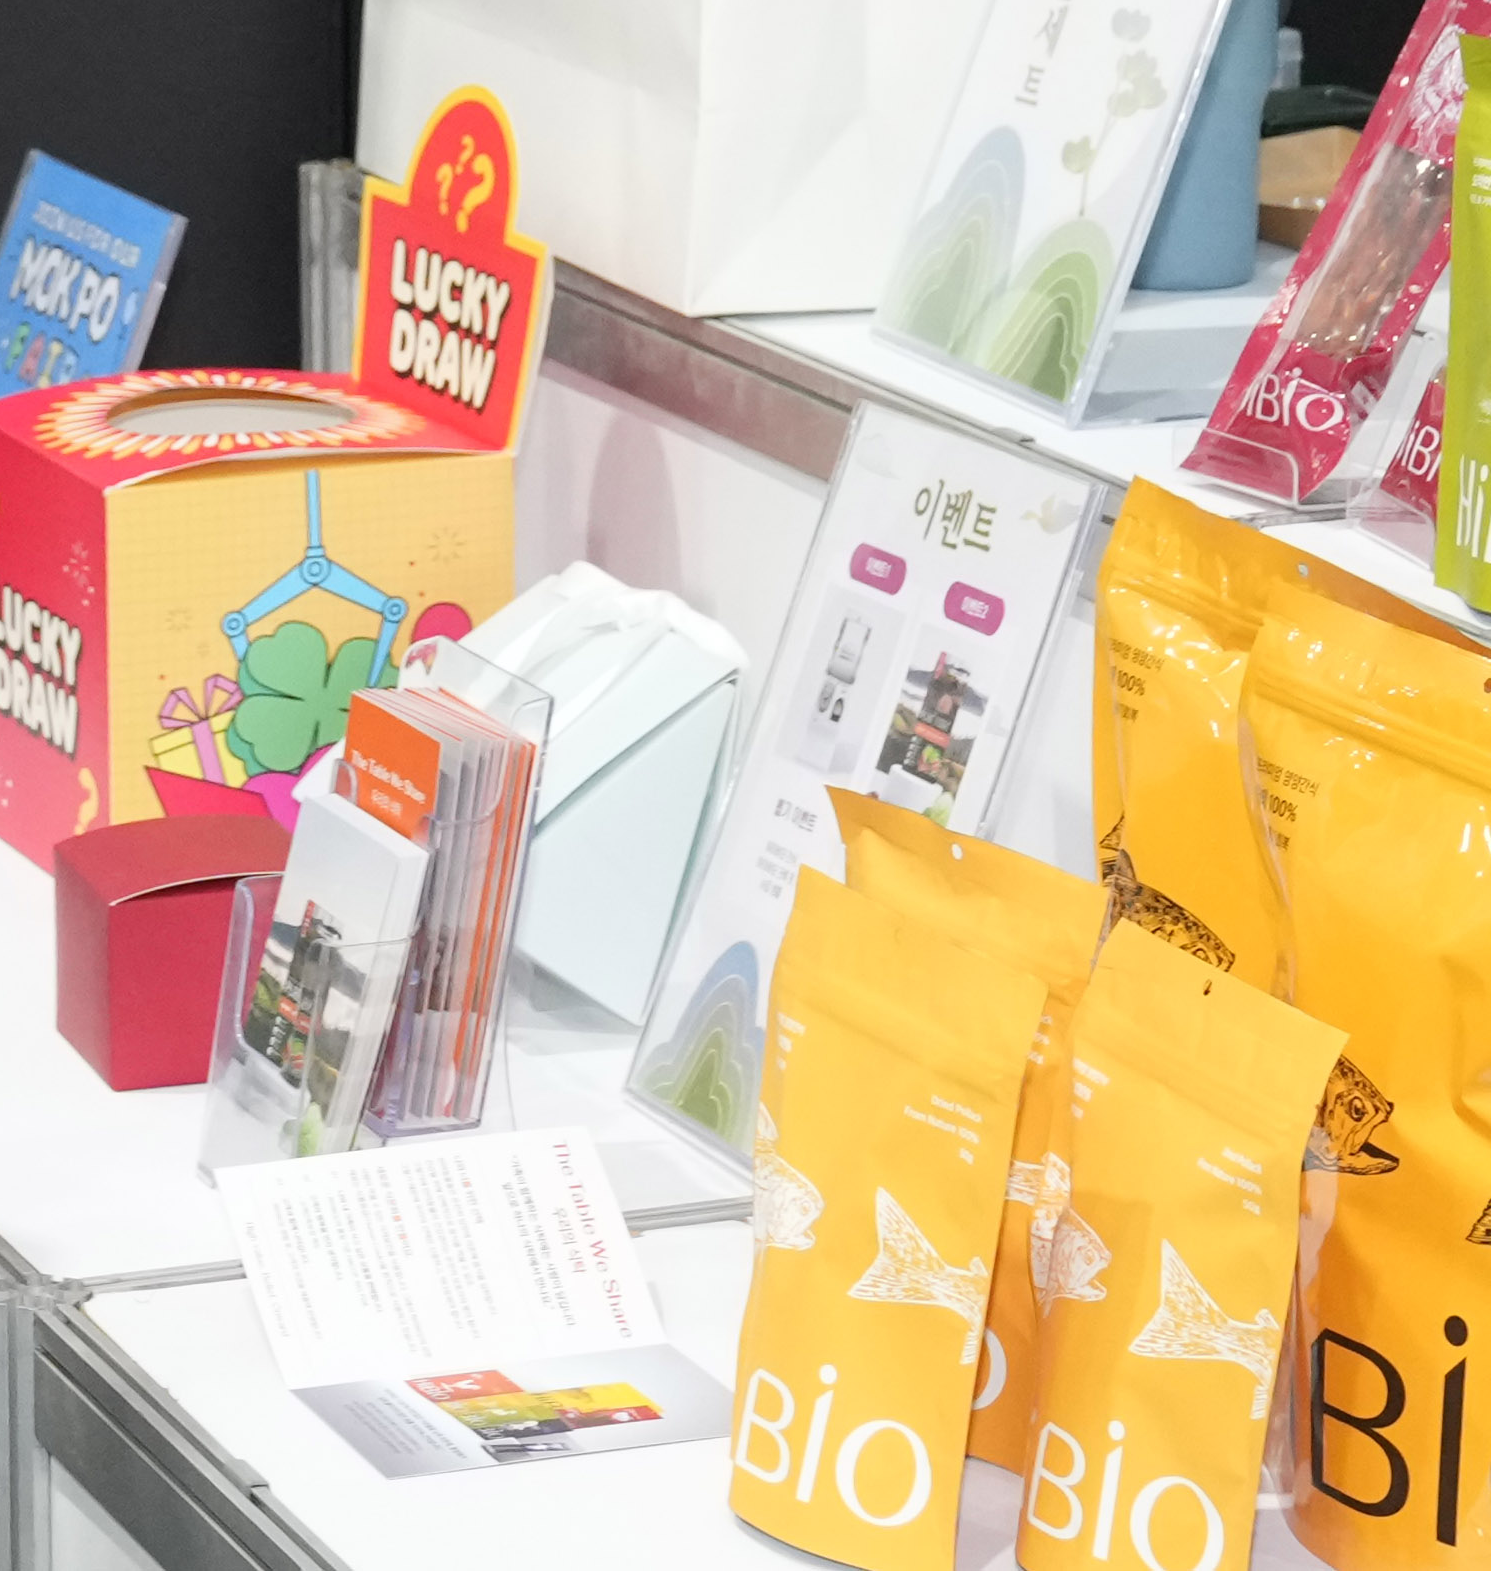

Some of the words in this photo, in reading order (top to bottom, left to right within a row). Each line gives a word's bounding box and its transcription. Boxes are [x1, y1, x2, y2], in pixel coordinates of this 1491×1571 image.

[390, 237, 511, 345] LUCKY
[389, 308, 497, 413] DRAW
[914, 479, 998, 553] 이벤트
[551, 1207, 578, 1246] 우리의
[567, 1248, 588, 1274] 식탁
[552, 1140, 574, 1177] The
[568, 1183, 596, 1236] Table
[589, 1239, 610, 1274] We
[602, 1277, 633, 1339] Share
